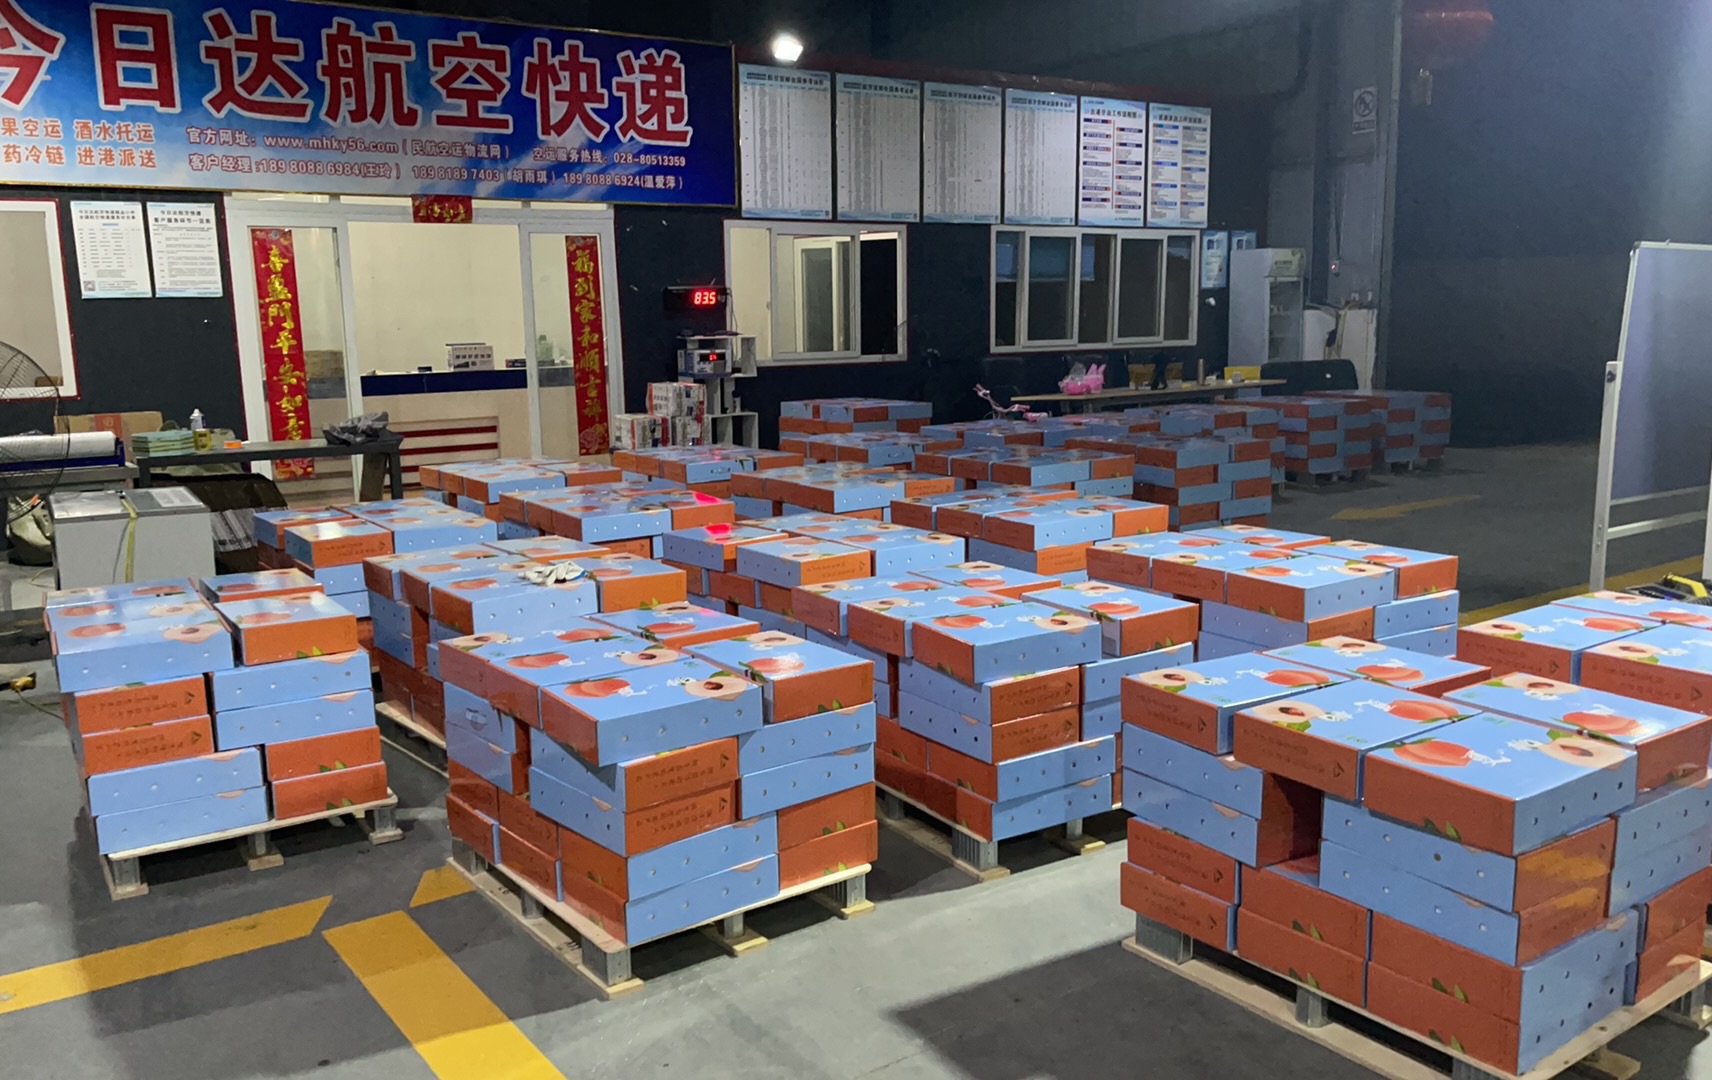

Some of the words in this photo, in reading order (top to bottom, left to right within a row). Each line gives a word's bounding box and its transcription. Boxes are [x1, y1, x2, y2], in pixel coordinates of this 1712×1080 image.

[0, 0, 692, 147] 今日达航空快递
[1, 117, 63, 139] 果空运
[74, 119, 155, 143] 酒水托运
[3, 143, 65, 165] 药冷链
[77, 146, 157, 168] 进港派送
[263, 133, 398, 154] www.mhky56.com
[613, 152, 686, 167] 028-80513359
